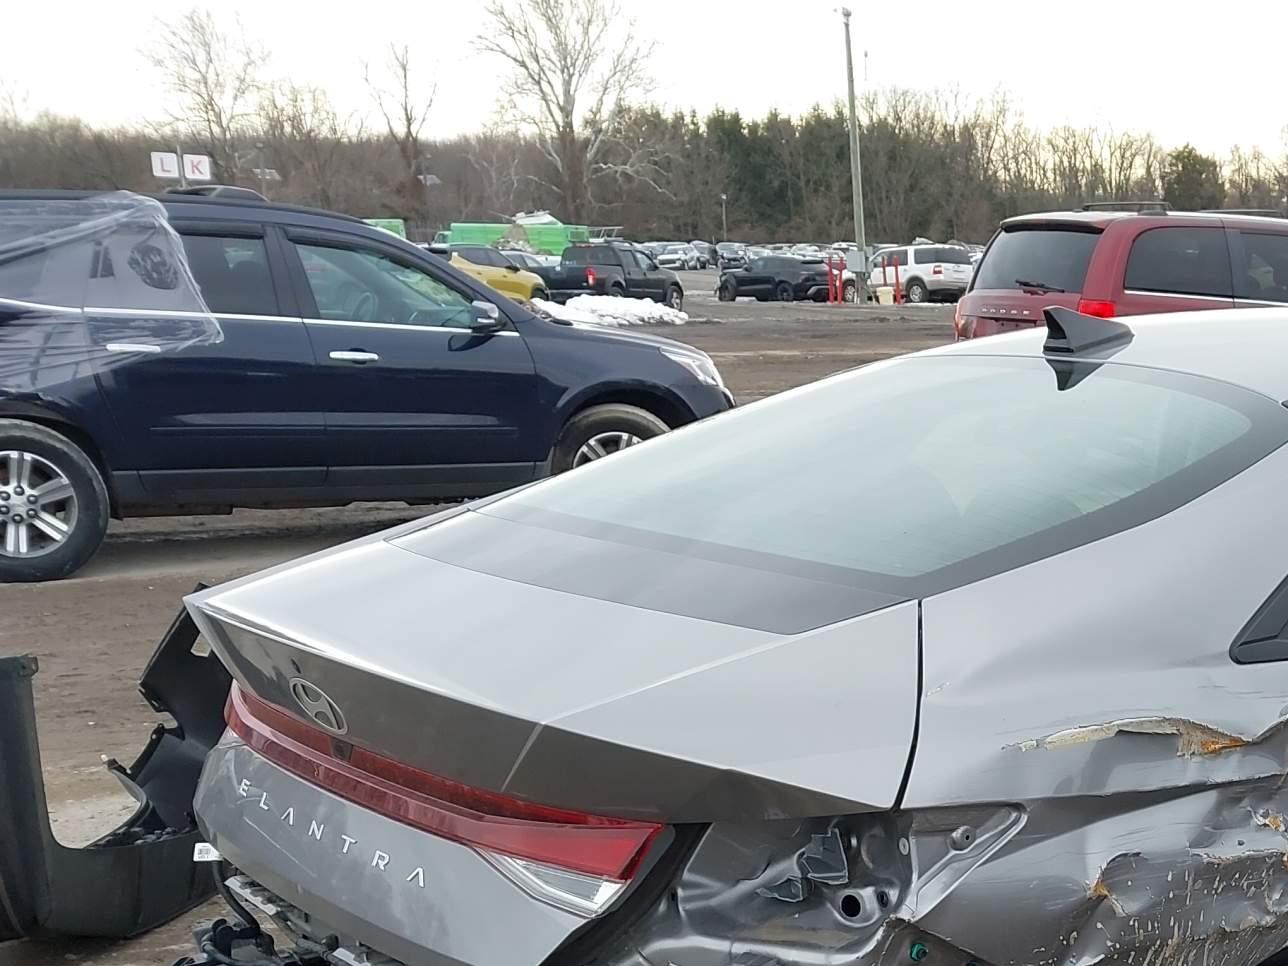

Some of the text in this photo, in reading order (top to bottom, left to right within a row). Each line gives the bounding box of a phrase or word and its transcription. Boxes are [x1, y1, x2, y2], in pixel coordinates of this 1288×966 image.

[160, 157, 171, 173] L
[190, 160, 204, 175] K
[239, 778, 426, 888] ELANTRA
